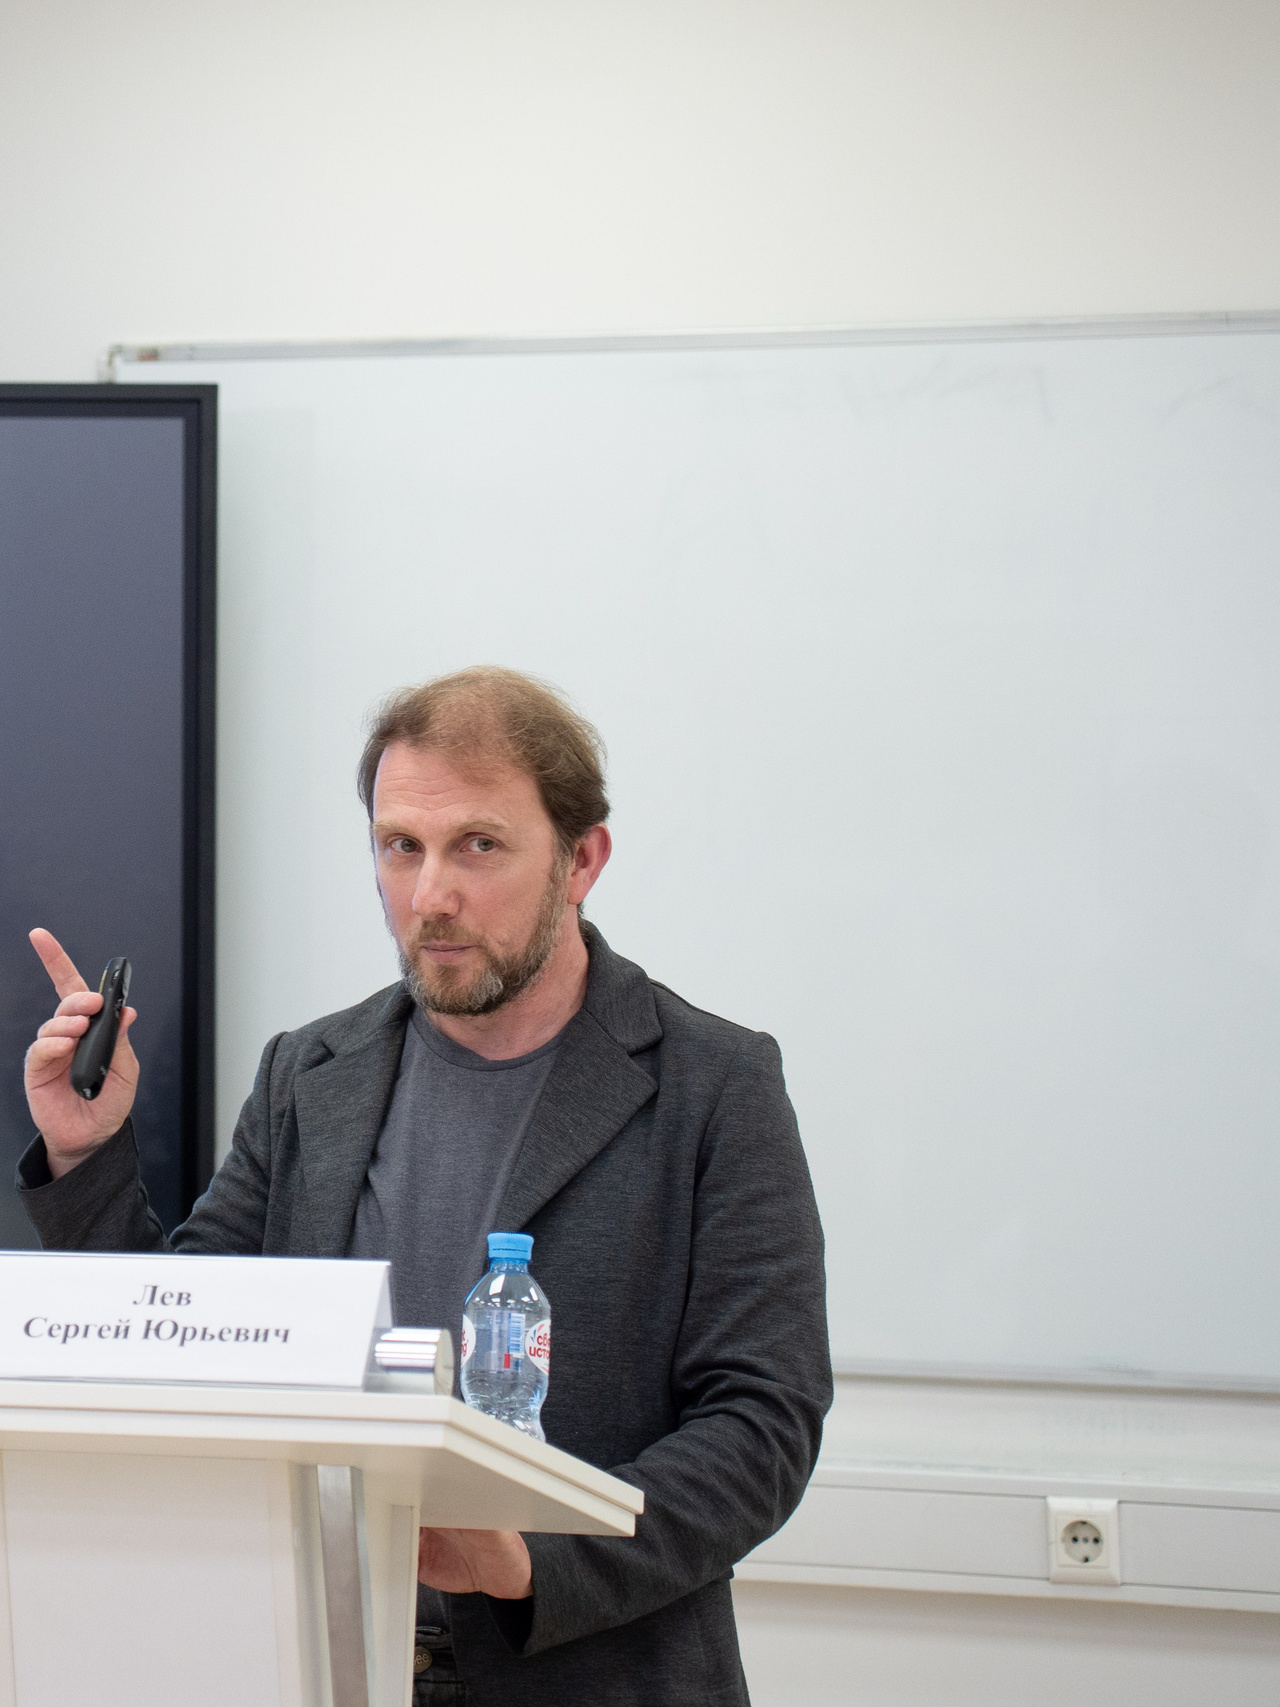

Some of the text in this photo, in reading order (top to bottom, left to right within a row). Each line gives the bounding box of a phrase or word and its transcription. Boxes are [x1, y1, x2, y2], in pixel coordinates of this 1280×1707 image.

[132, 1284, 192, 1307] Лев
[23, 1316, 291, 1347] Сергей Юрьевич
[414, 1653, 429, 1664] ee
